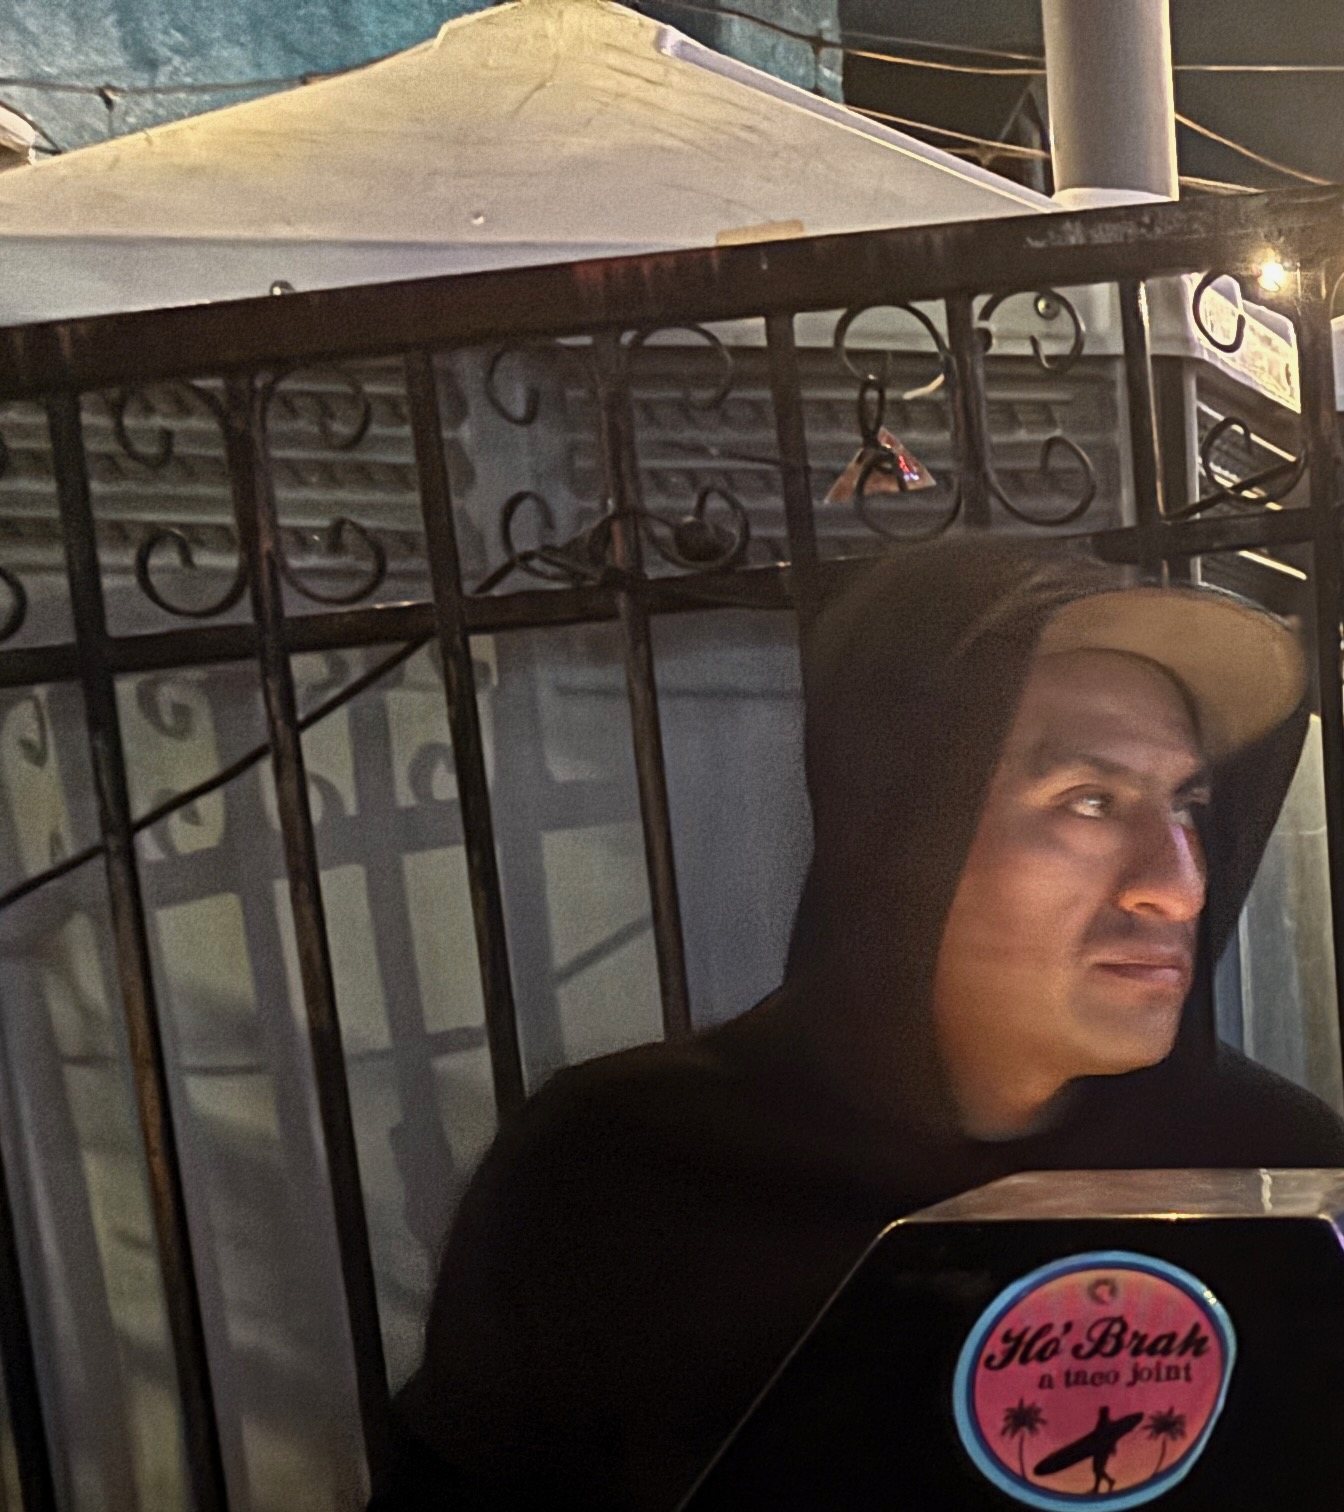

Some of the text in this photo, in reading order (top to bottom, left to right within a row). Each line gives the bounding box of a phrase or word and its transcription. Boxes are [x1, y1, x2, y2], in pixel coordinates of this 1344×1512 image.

[1038, 1361, 1192, 1390] a taco joint
